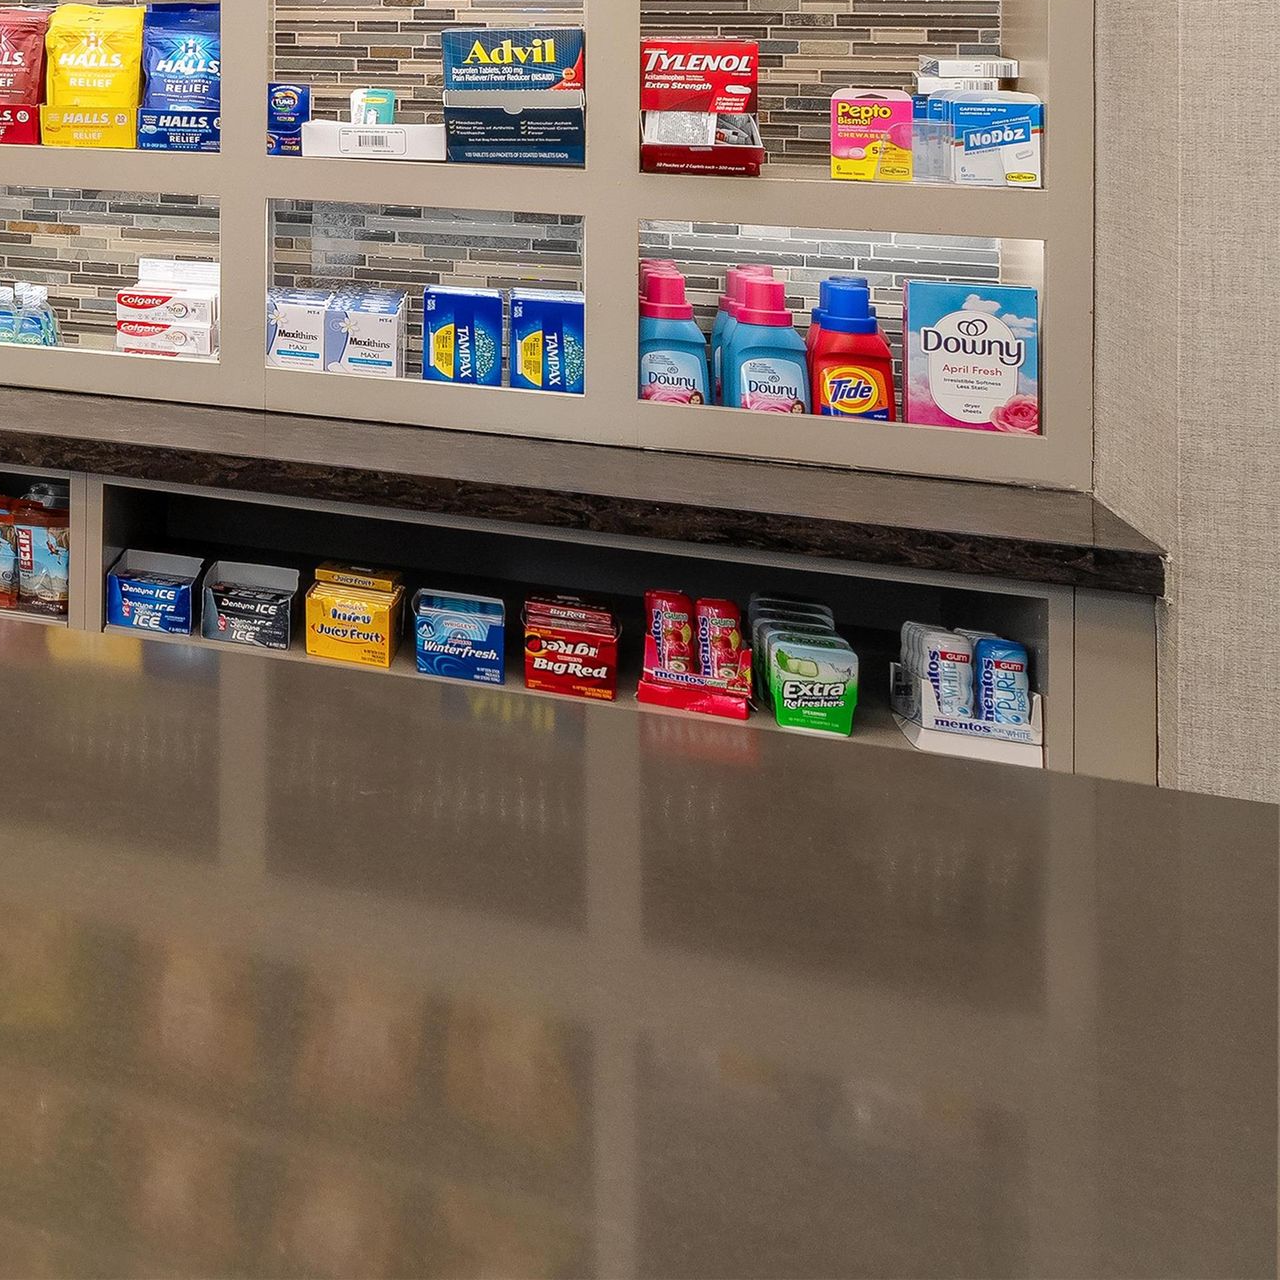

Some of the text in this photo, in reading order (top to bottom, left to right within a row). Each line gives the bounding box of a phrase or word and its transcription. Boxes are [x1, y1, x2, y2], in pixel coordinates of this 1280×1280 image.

[463, 39, 557, 64] Advil
[59, 53, 123, 68] HALLS
[643, 50, 750, 72] TYLENOL
[452, 67, 478, 75] Ibuprofen
[479, 67, 500, 75] Tablets,
[467, 74, 506, 82] Reliever/Fever
[508, 74, 531, 82] Reducer
[532, 73, 555, 82] (NSAID)
[644, 74, 685, 82] Acetaminophen
[644, 82, 712, 91] Extra Strength
[837, 103, 891, 119] Pepto
[837, 117, 871, 125] Bismol
[121, 295, 162, 306] Colgate
[277, 329, 318, 342] Maxithins
[456, 325, 472, 378] TAMPAX
[923, 328, 1023, 364] Downy
[360, 351, 379, 359] MAXI
[942, 363, 1002, 376] April Fresh
[648, 371, 697, 392] Downy
[829, 379, 872, 402] Tide
[122, 584, 175, 600] Dentyne ICE
[317, 624, 380, 643] Juicy Fruit
[946, 654, 968, 663] GUM
[534, 658, 607, 679] Big Red
[1000, 662, 1021, 671] GUM
[653, 670, 705, 686] mentos
[783, 681, 845, 699] Extra
[983, 658, 995, 722] mentos
[997, 670, 1017, 711] PURE
[783, 697, 844, 708] Refreshers
[934, 719, 991, 733] mentos
